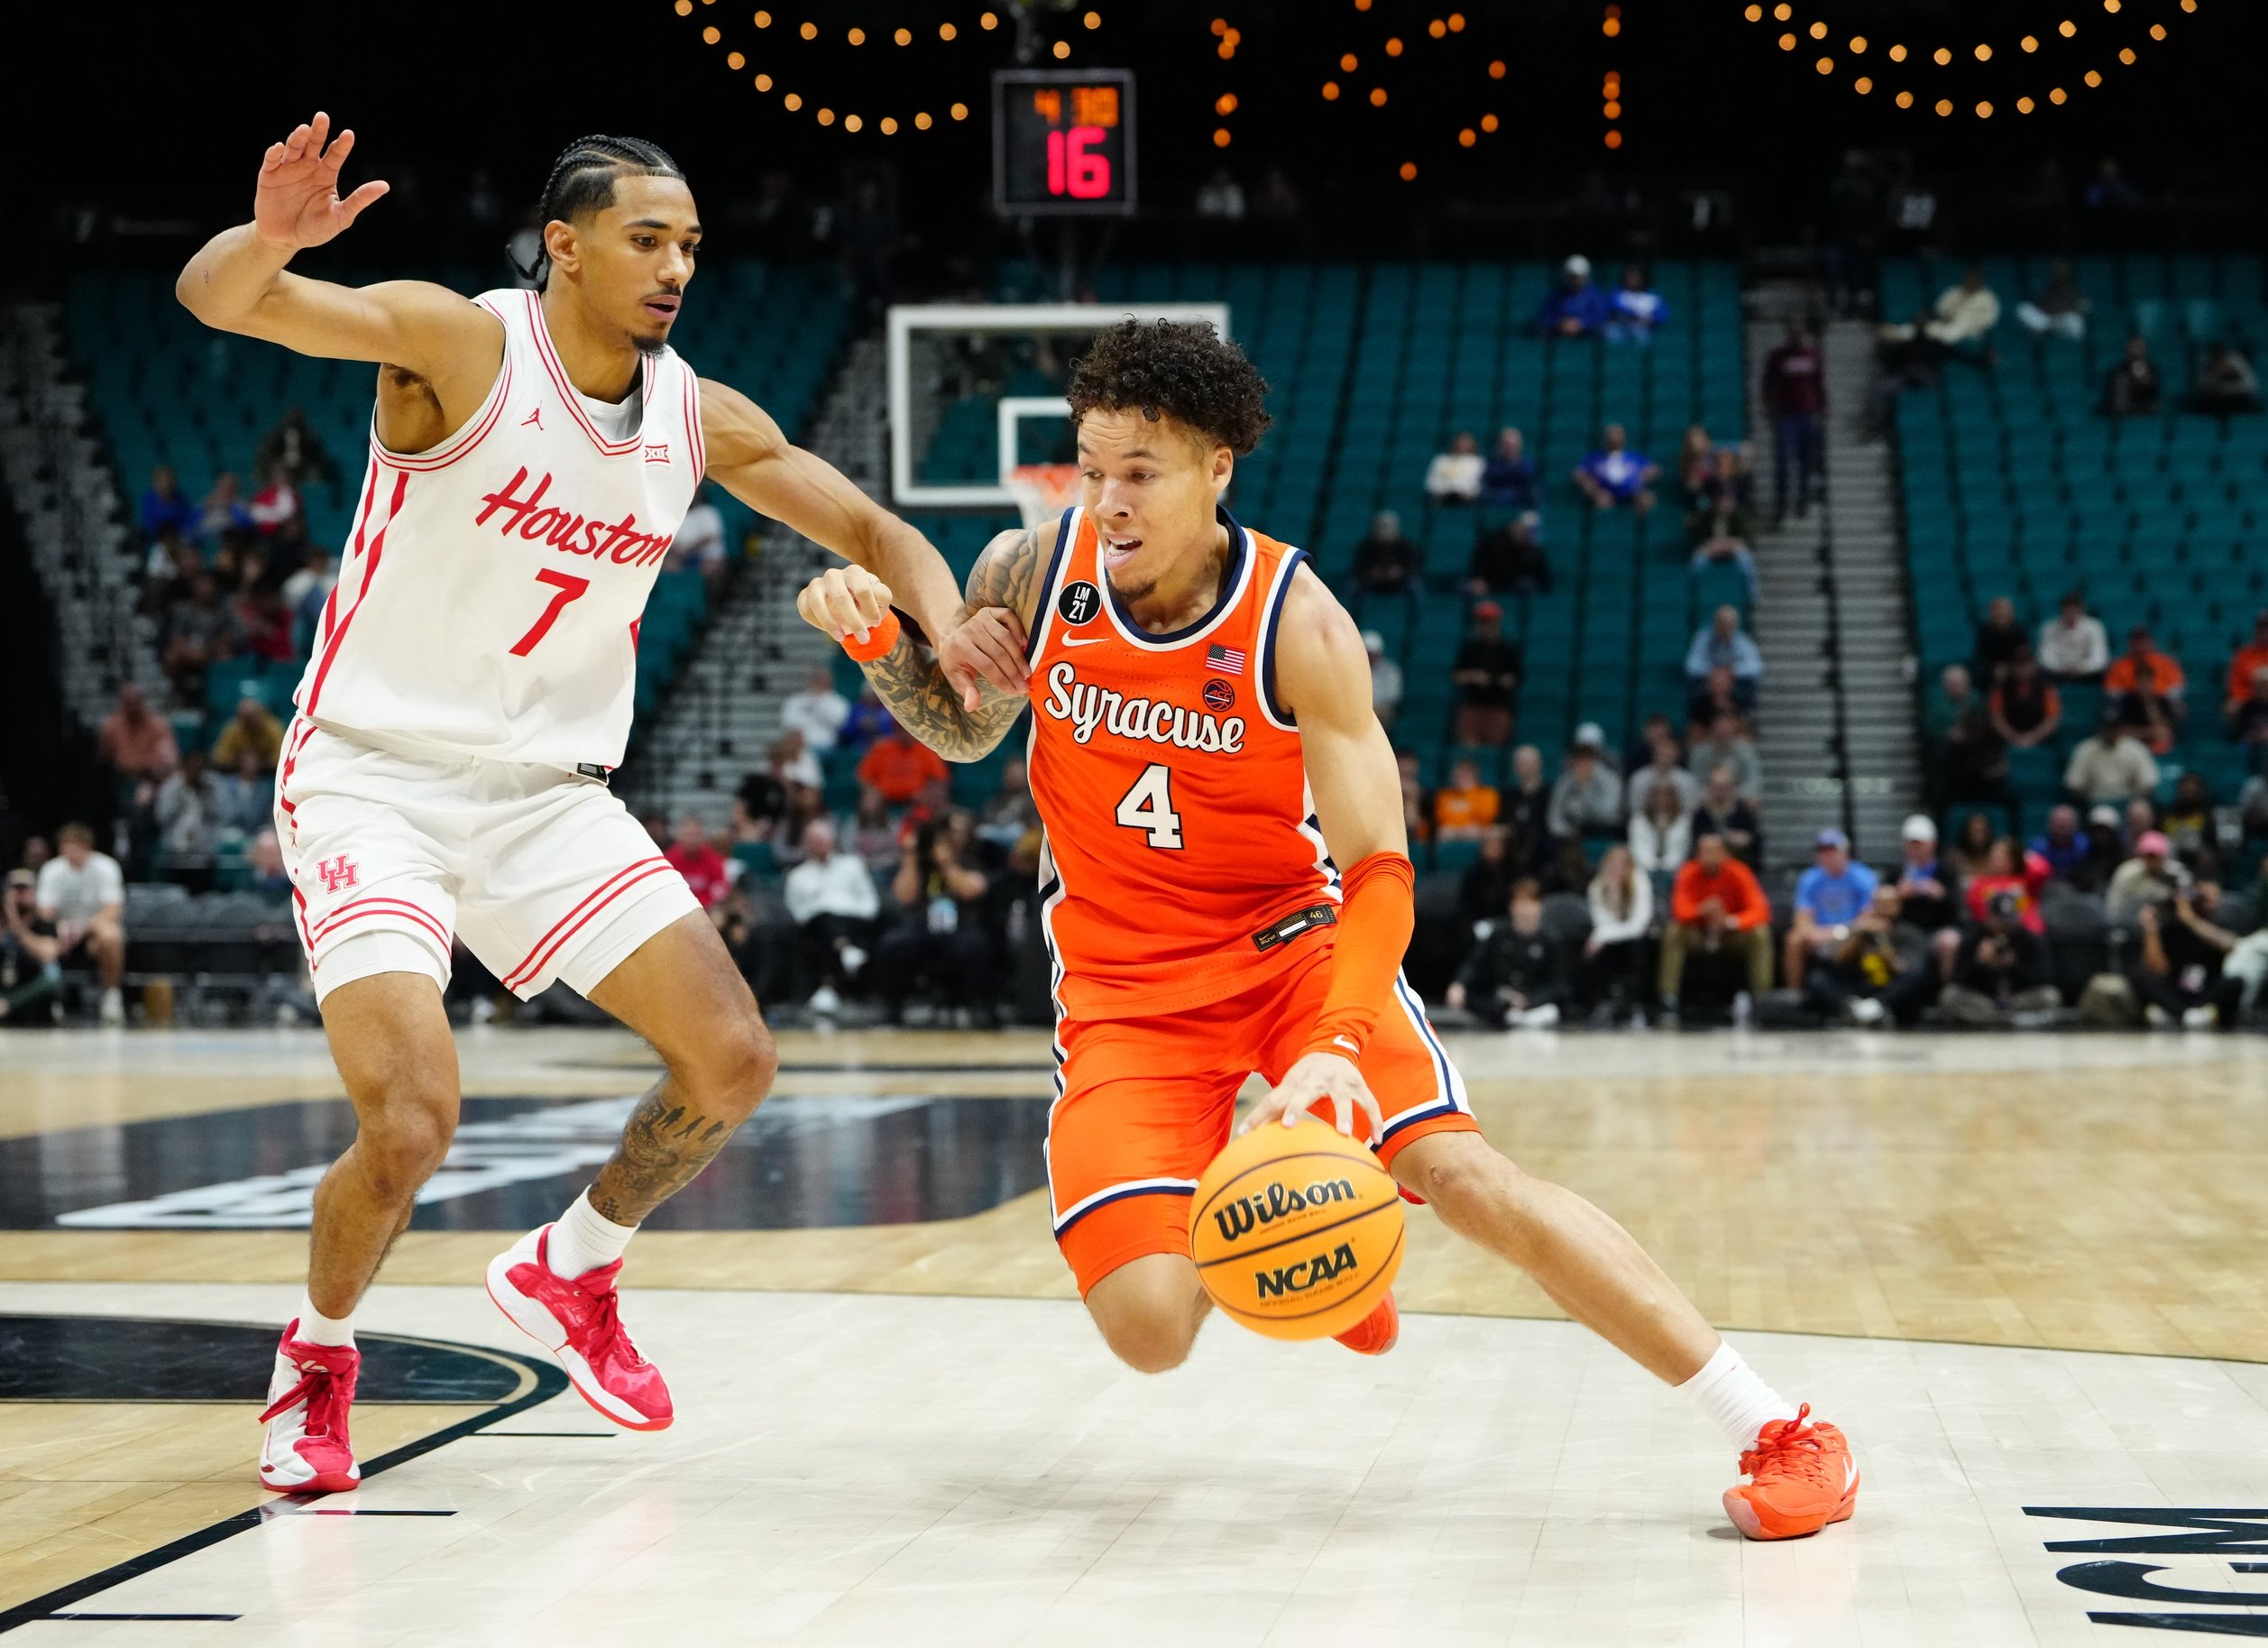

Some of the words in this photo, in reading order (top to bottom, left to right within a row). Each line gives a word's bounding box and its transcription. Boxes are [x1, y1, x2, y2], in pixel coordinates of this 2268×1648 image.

[1046, 125, 1111, 199] 16
[475, 465, 673, 567] Houston
[509, 567, 590, 657] 7
[1068, 600, 1088, 621] 21
[1074, 585, 1091, 602] LM
[1044, 660, 1245, 754] Syracuse
[1115, 762, 1185, 850] 4
[1309, 910, 1323, 919] 46
[1214, 1178, 1355, 1241] Wilson
[1254, 1242, 1358, 1299] NCAA
